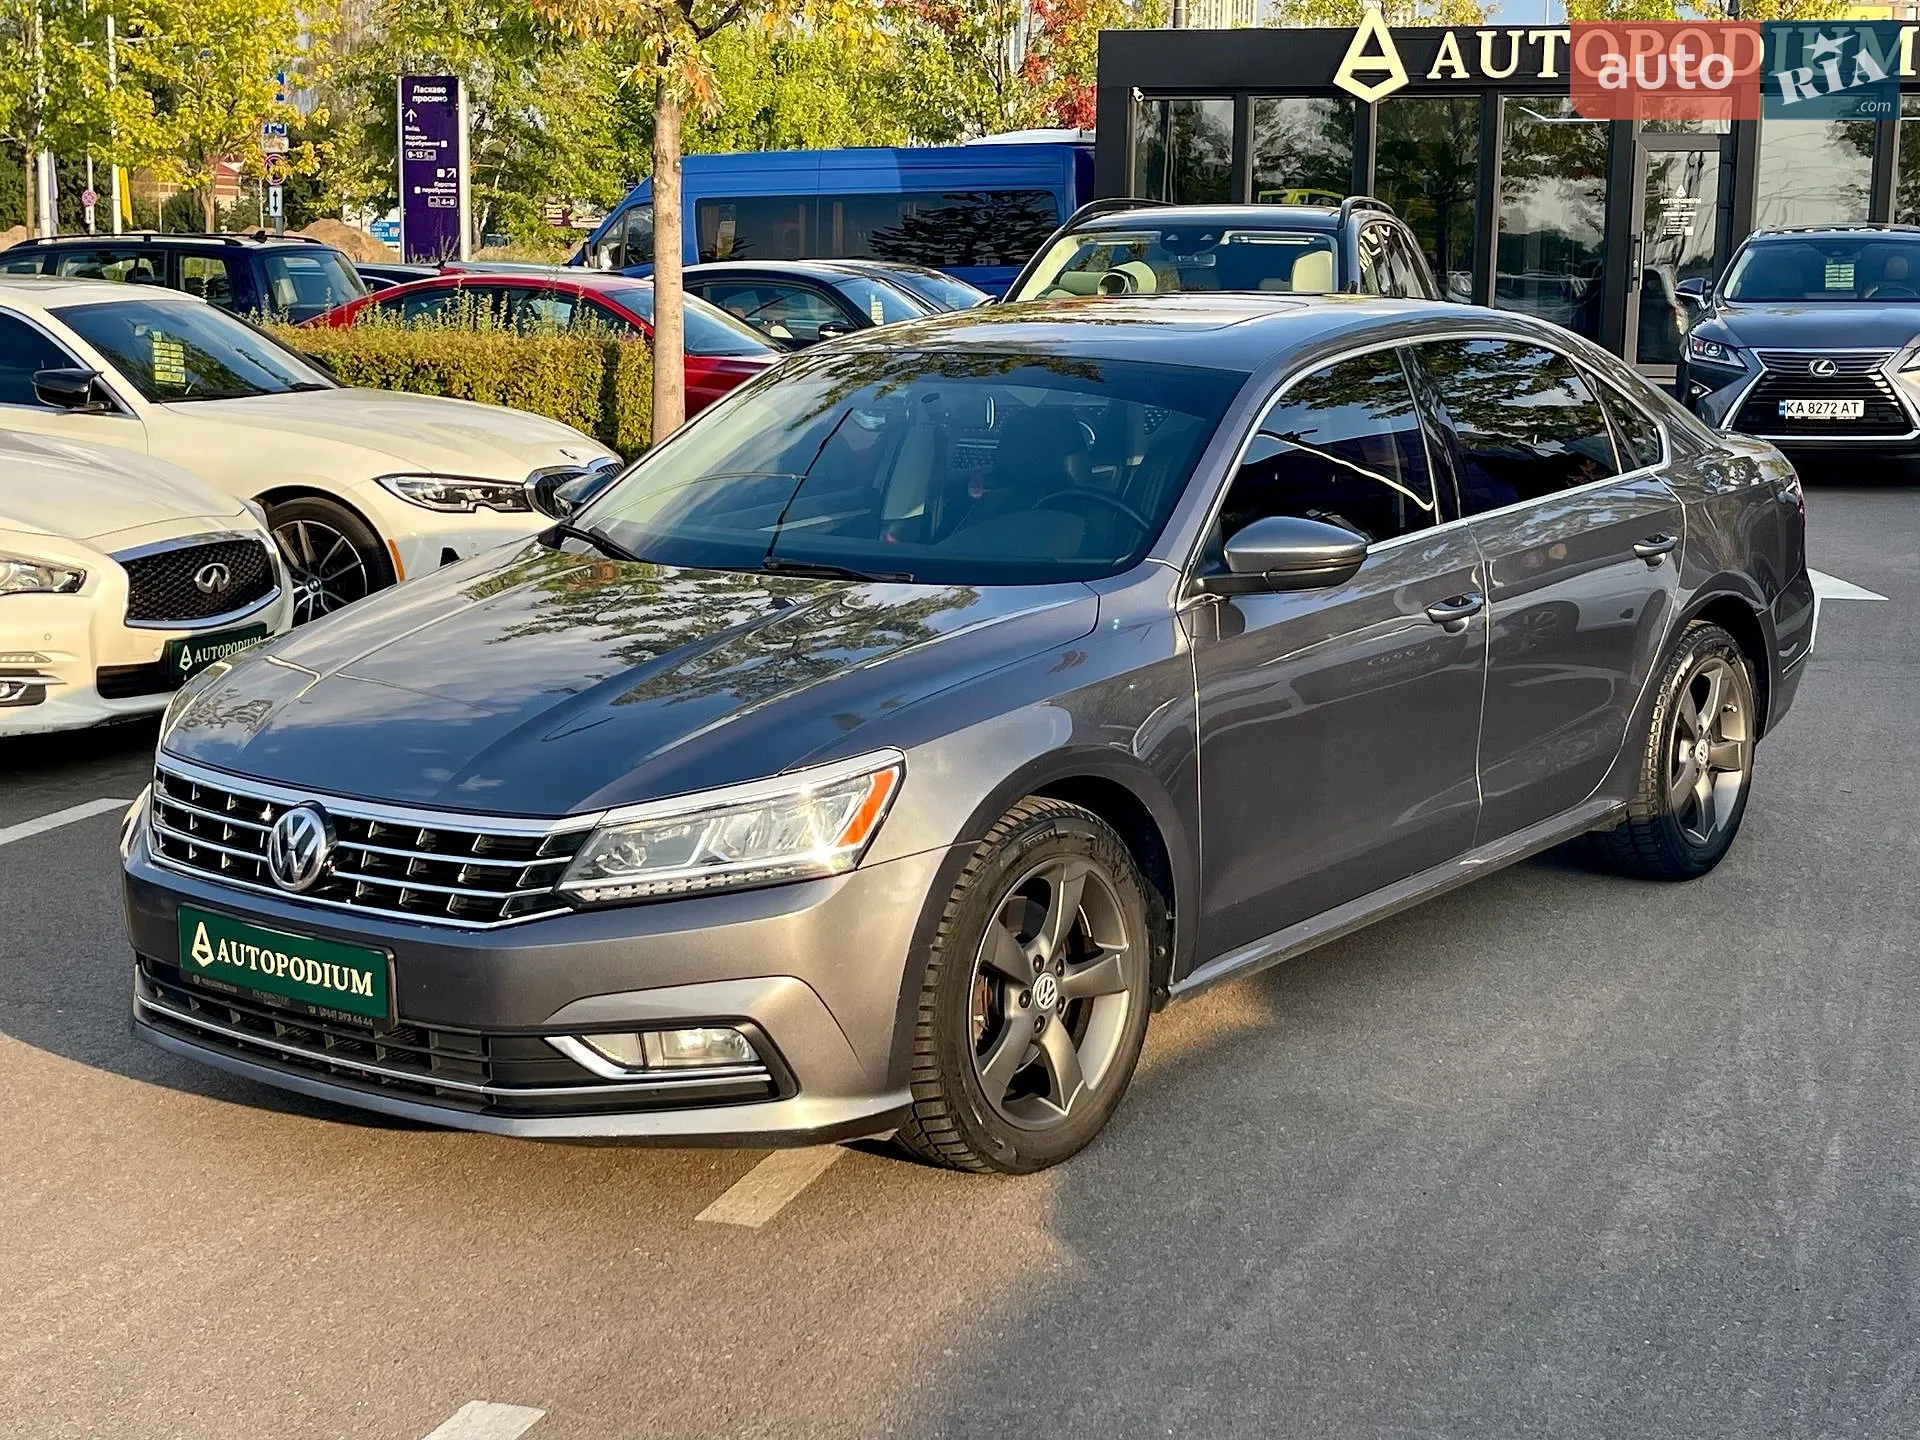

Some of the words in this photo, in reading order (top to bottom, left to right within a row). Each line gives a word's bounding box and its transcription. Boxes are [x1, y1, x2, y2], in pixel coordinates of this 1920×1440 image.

[1426, 27, 1918, 79] AUTOPODIUM
[1786, 402, 1804, 414] KA
[1808, 402, 1838, 414] 8272
[1841, 402, 1860, 414] AT
[217, 938, 373, 997] AUTOPODIUM
